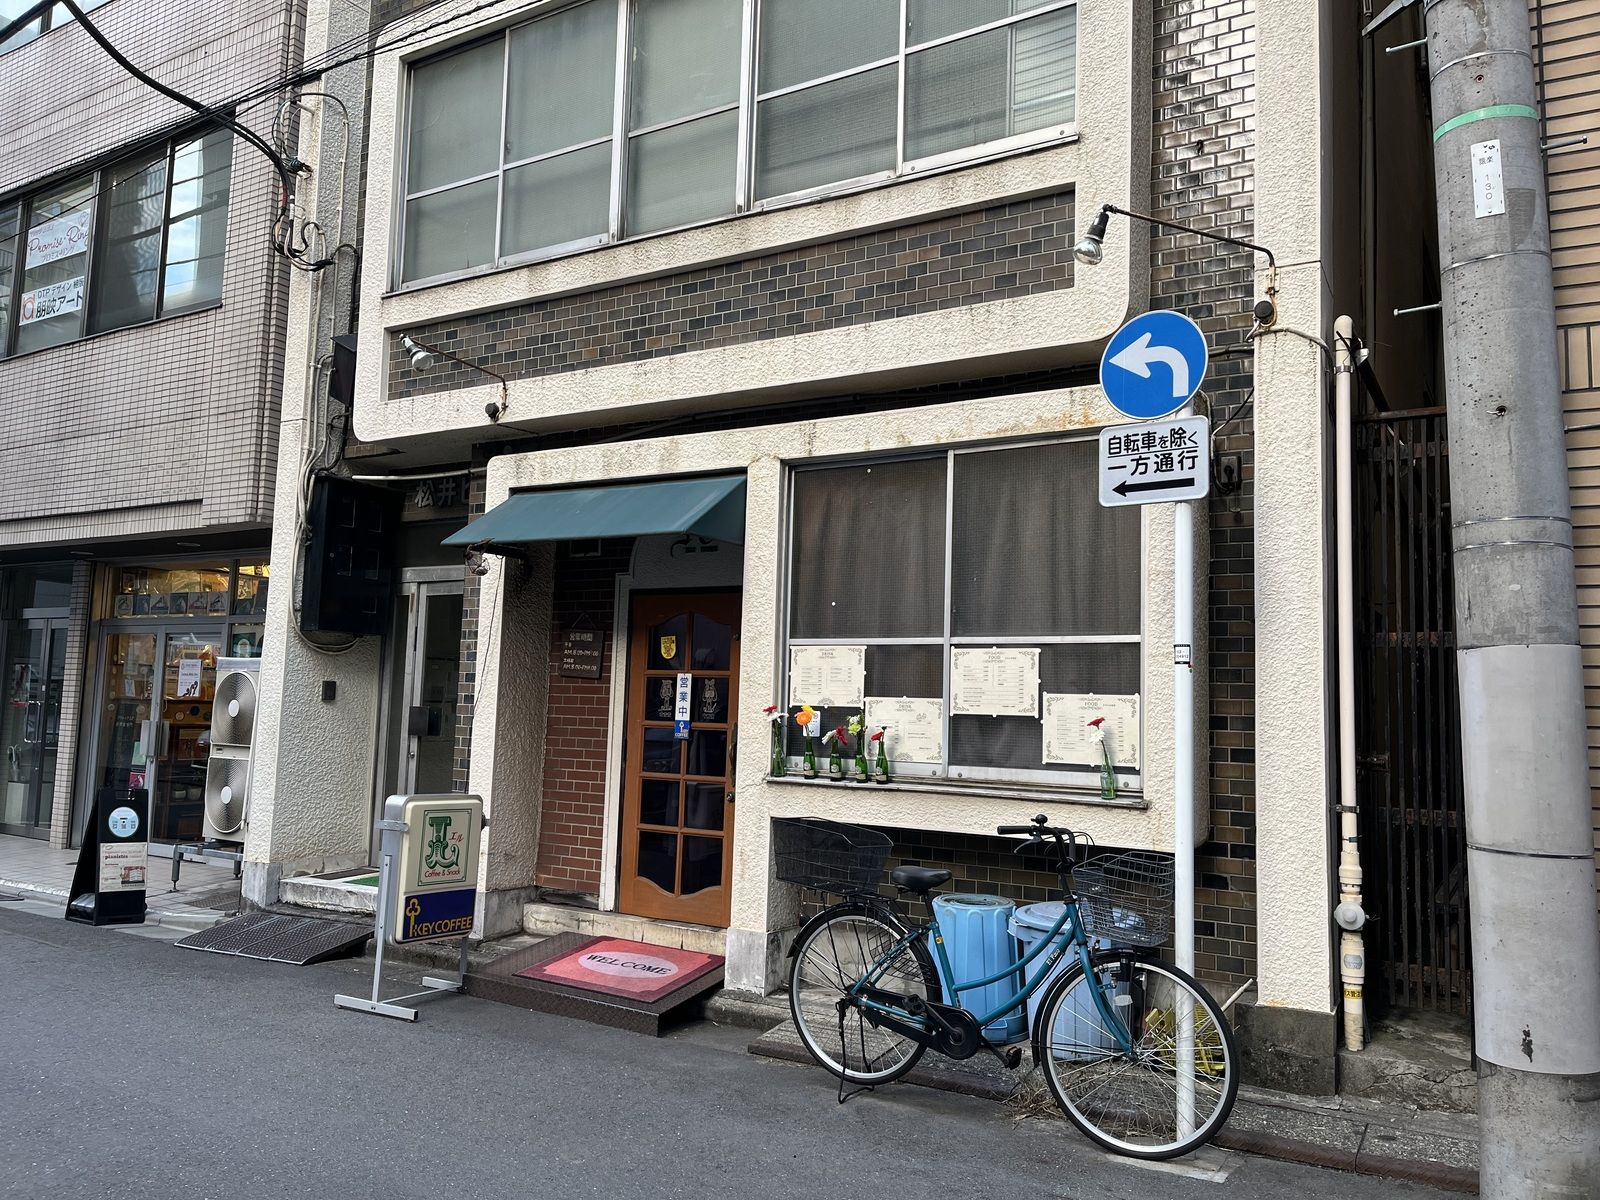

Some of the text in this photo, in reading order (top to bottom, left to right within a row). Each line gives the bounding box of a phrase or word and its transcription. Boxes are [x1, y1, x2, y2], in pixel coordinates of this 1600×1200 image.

[37, 288, 51, 299] DTP
[1108, 426, 1198, 455] 自転車を除く
[1107, 449, 1199, 476] 一方通行
[679, 677, 689, 717] 営業中
[415, 916, 472, 936] KEY COFFEE
[587, 954, 671, 975] WELCOME
